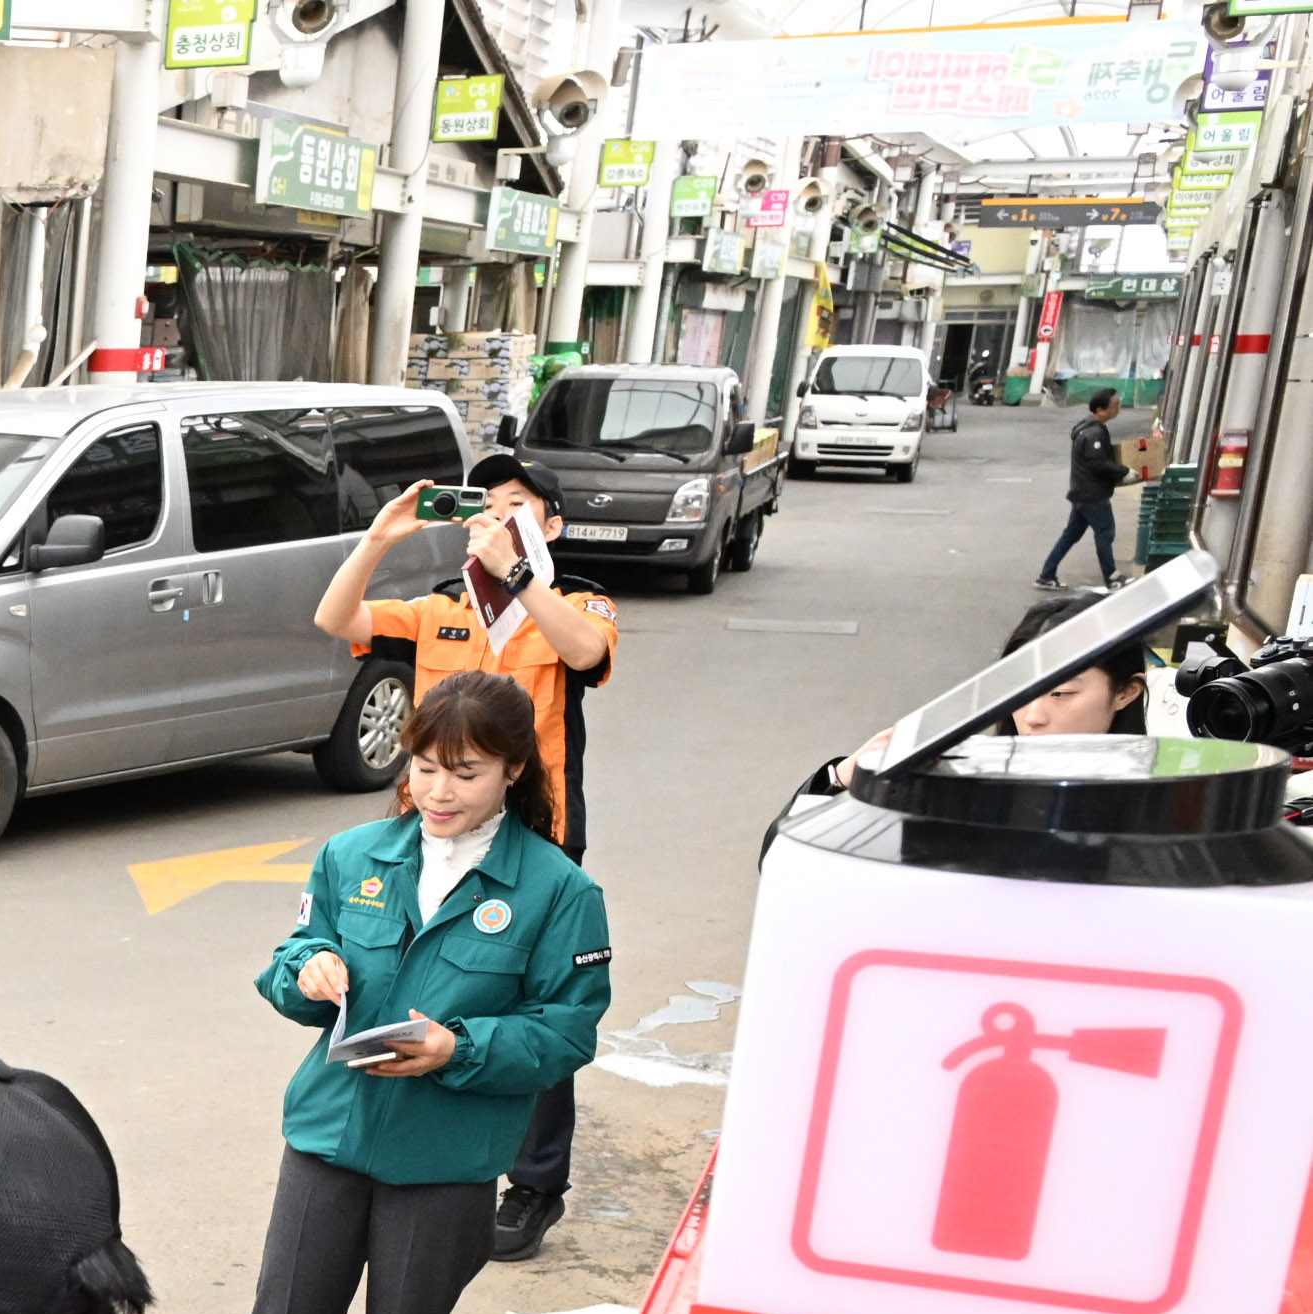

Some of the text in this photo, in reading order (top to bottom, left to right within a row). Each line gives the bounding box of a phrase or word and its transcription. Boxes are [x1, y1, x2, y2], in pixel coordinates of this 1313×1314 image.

[176, 31, 240, 54] 충청상회
[440, 116, 490, 134] 동원상회
[1203, 127, 1250, 143] 어울림
[299, 134, 360, 192] 동원상회
